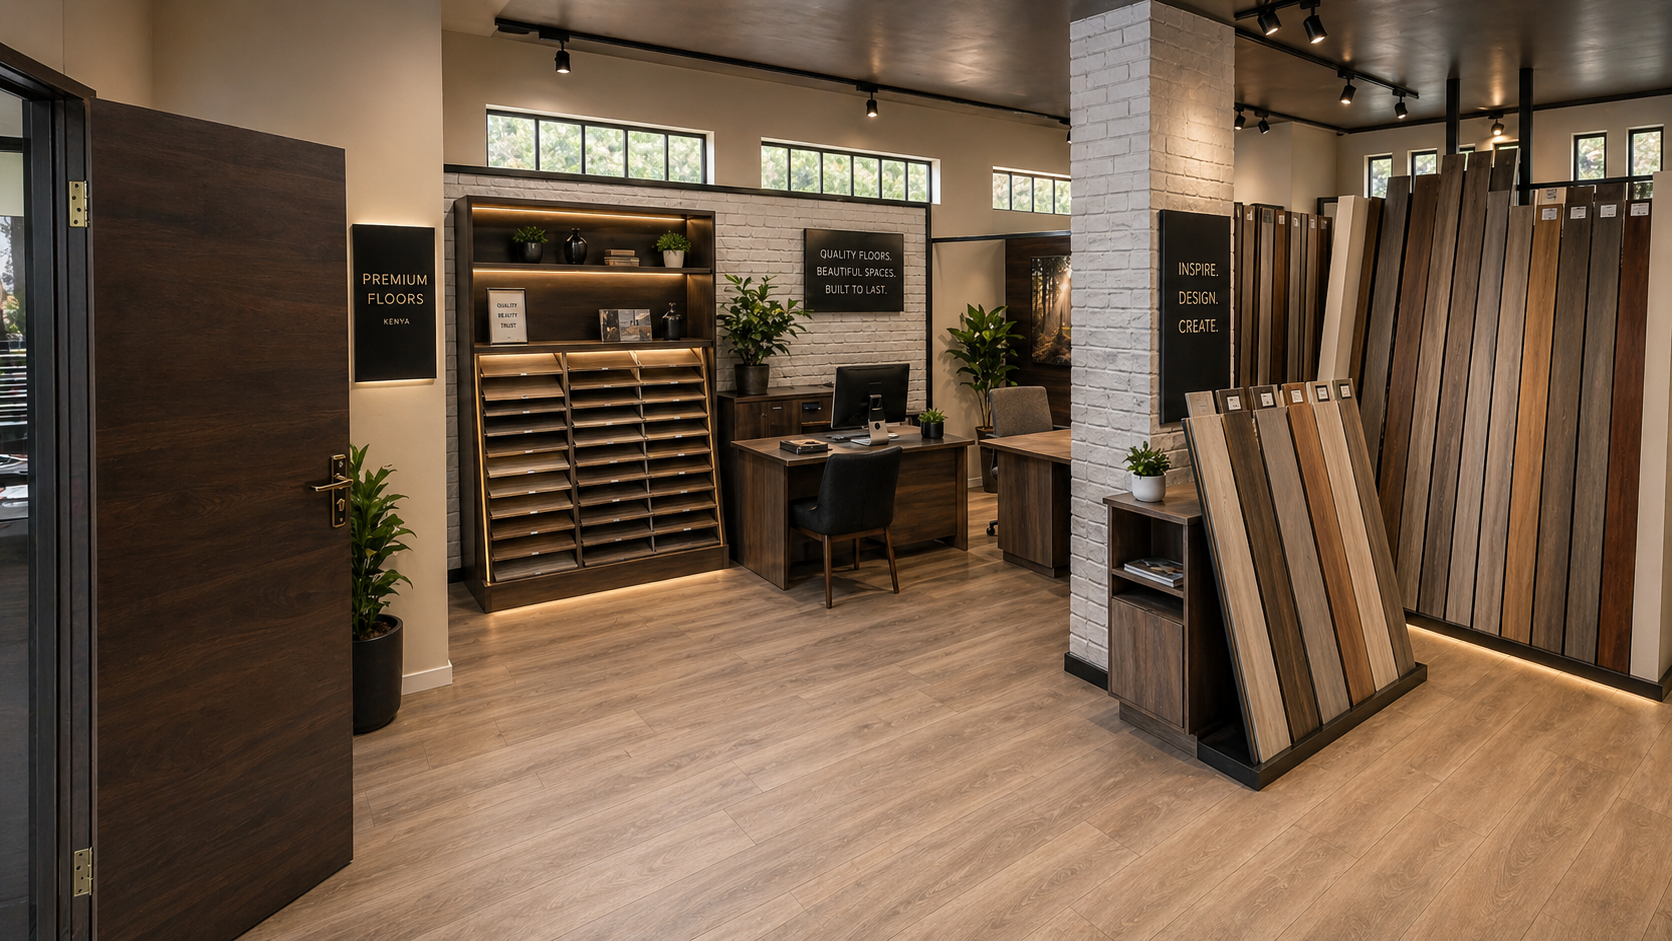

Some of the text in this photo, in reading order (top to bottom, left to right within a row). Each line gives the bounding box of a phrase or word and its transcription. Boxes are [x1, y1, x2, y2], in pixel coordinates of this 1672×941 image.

[819, 249, 893, 261] QUALITY FLOORS.
[816, 266, 897, 278] BEAUTIFUL SPACES.
[1178, 262, 1219, 277] INSPIRE.
[362, 273, 428, 286] PREMIUM
[825, 284, 888, 295] BUILT TO LAST.
[367, 292, 424, 305] FLOORS
[1178, 291, 1219, 305] DESIGN.
[1178, 319, 1219, 334] CREATE.
